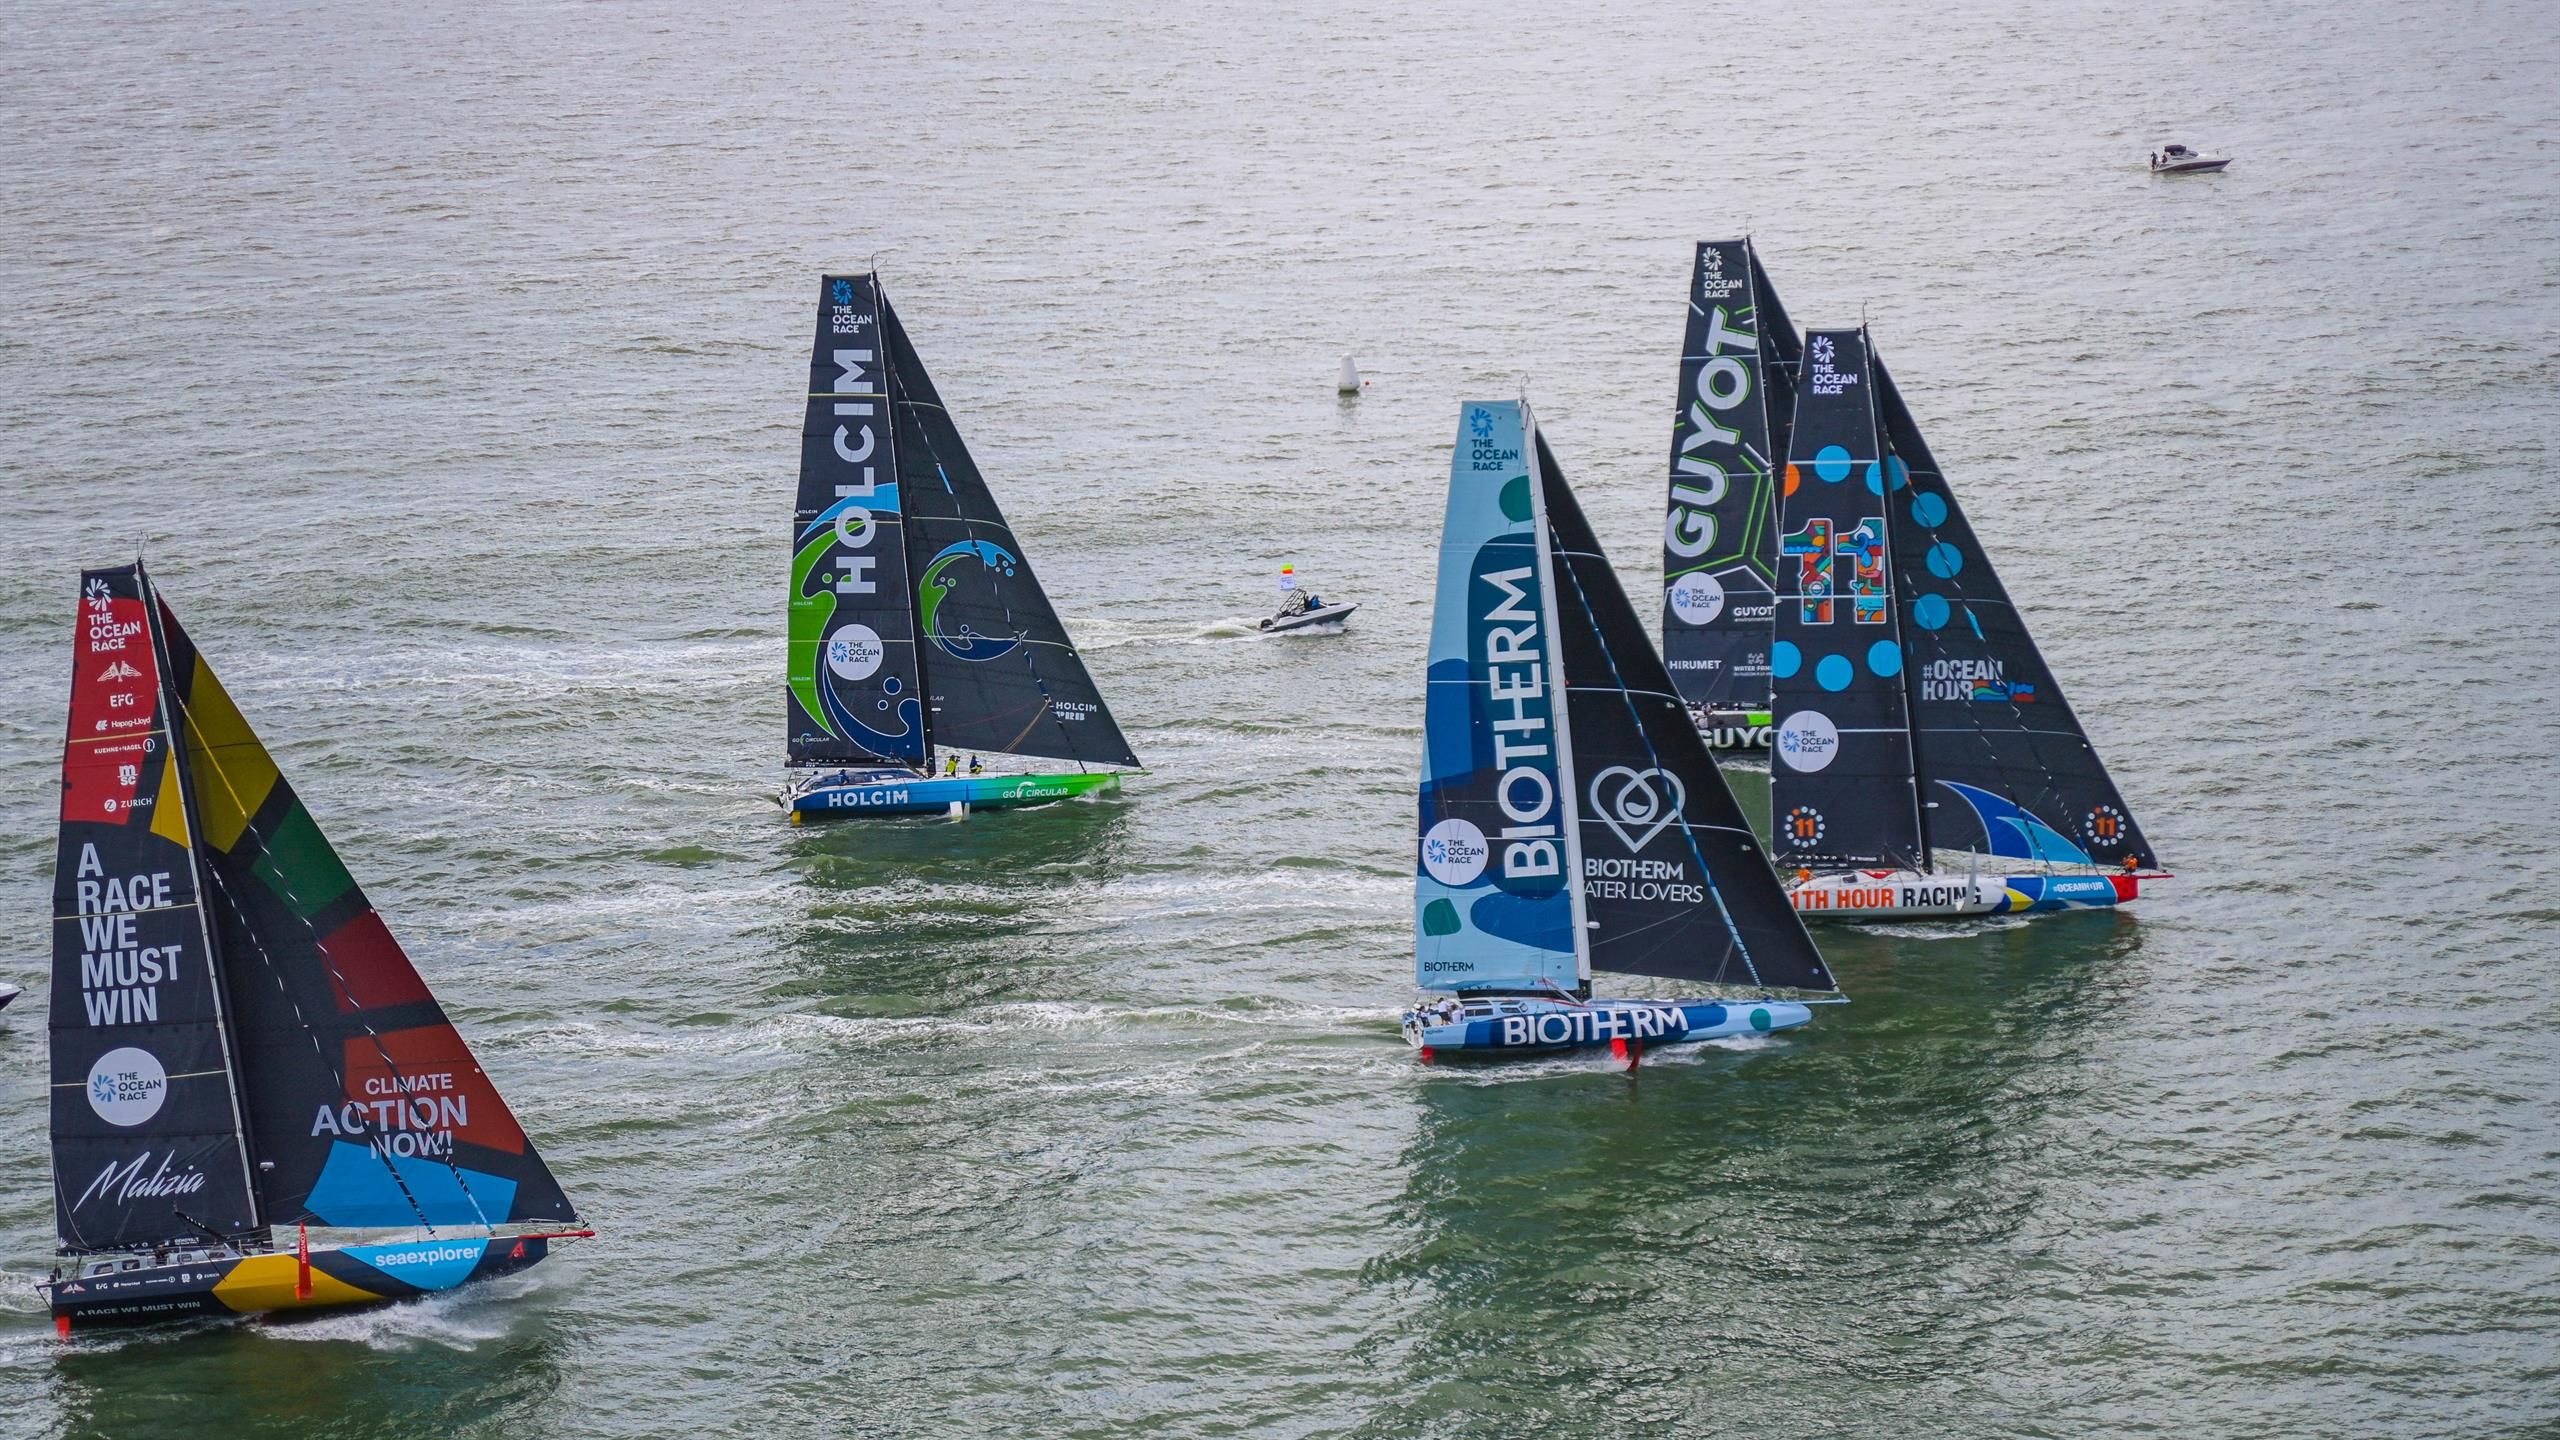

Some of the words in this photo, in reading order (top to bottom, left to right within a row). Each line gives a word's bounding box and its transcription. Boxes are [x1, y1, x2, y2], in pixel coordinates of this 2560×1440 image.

[1704, 271, 1722, 280] THE
[1704, 279, 1743, 289] OCEAN
[1704, 289, 1730, 298] RACE
[833, 305, 852, 314] THE
[832, 315, 872, 324] OCEAN
[833, 325, 859, 333] RACE
[1812, 363, 1834, 373] THE
[1812, 373, 1858, 384] OCEAN
[1812, 384, 1843, 394] RACE
[1665, 304, 1759, 557] GUYOT
[1472, 439, 1494, 448] THE
[1472, 449, 1518, 460] OCEAN
[833, 349, 876, 594] HOLCIM
[1472, 461, 1504, 471] RACE
[1781, 516, 1887, 624] 11
[1733, 606, 1774, 616] GUYOT
[88, 612, 114, 626] THE
[89, 621, 142, 640] OCEAN
[91, 638, 126, 652] RACE
[1669, 660, 1722, 670] HIRUMET
[1923, 660, 2003, 680] #OCEAN
[1923, 681, 1974, 700] HOUR
[110, 693, 134, 708] EFG
[1055, 701, 1097, 712] HOLCIM
[111, 716, 151, 729] Hapag-Lloyd
[1479, 565, 1560, 879] BIOTHERM
[1801, 737, 1834, 745] OCEAN
[828, 789, 909, 808] HOLCIM
[1002, 790, 1017, 799] GO
[1026, 787, 1069, 797] CIRCULAR
[120, 797, 153, 809] ZURICH
[1796, 818, 1817, 837] 11
[2096, 817, 2116, 836] 11
[1448, 839, 1465, 847] THE
[1448, 847, 1484, 856] OCEAN
[77, 842, 104, 878] A
[1448, 856, 1472, 864] RACE
[1584, 858, 1684, 881] BIOTHERM
[77, 872, 172, 915] RACE
[1584, 880, 1626, 899] ATER
[1631, 882, 1704, 903] LOVERS
[1837, 887, 1895, 909] HOUR
[79, 913, 138, 951] WE
[81, 944, 182, 988] MUST
[1424, 962, 1474, 971] BIOTHERM
[83, 986, 158, 1026] WIN
[1504, 1008, 1688, 1046] BIOTHERM
[117, 1072, 138, 1081] THE
[118, 1079, 162, 1091] OCEAN
[365, 1073, 453, 1095] CLIMATE
[119, 1091, 148, 1101] RACE
[311, 1095, 468, 1137] ACTION
[370, 1131, 453, 1160] NOW!
[73, 1149, 206, 1213] Malizia
[375, 1246, 481, 1270] seaexplorer
[87, 1307, 118, 1316] RACE
[142, 1303, 174, 1312] MUST
[177, 1301, 200, 1309] WIN
